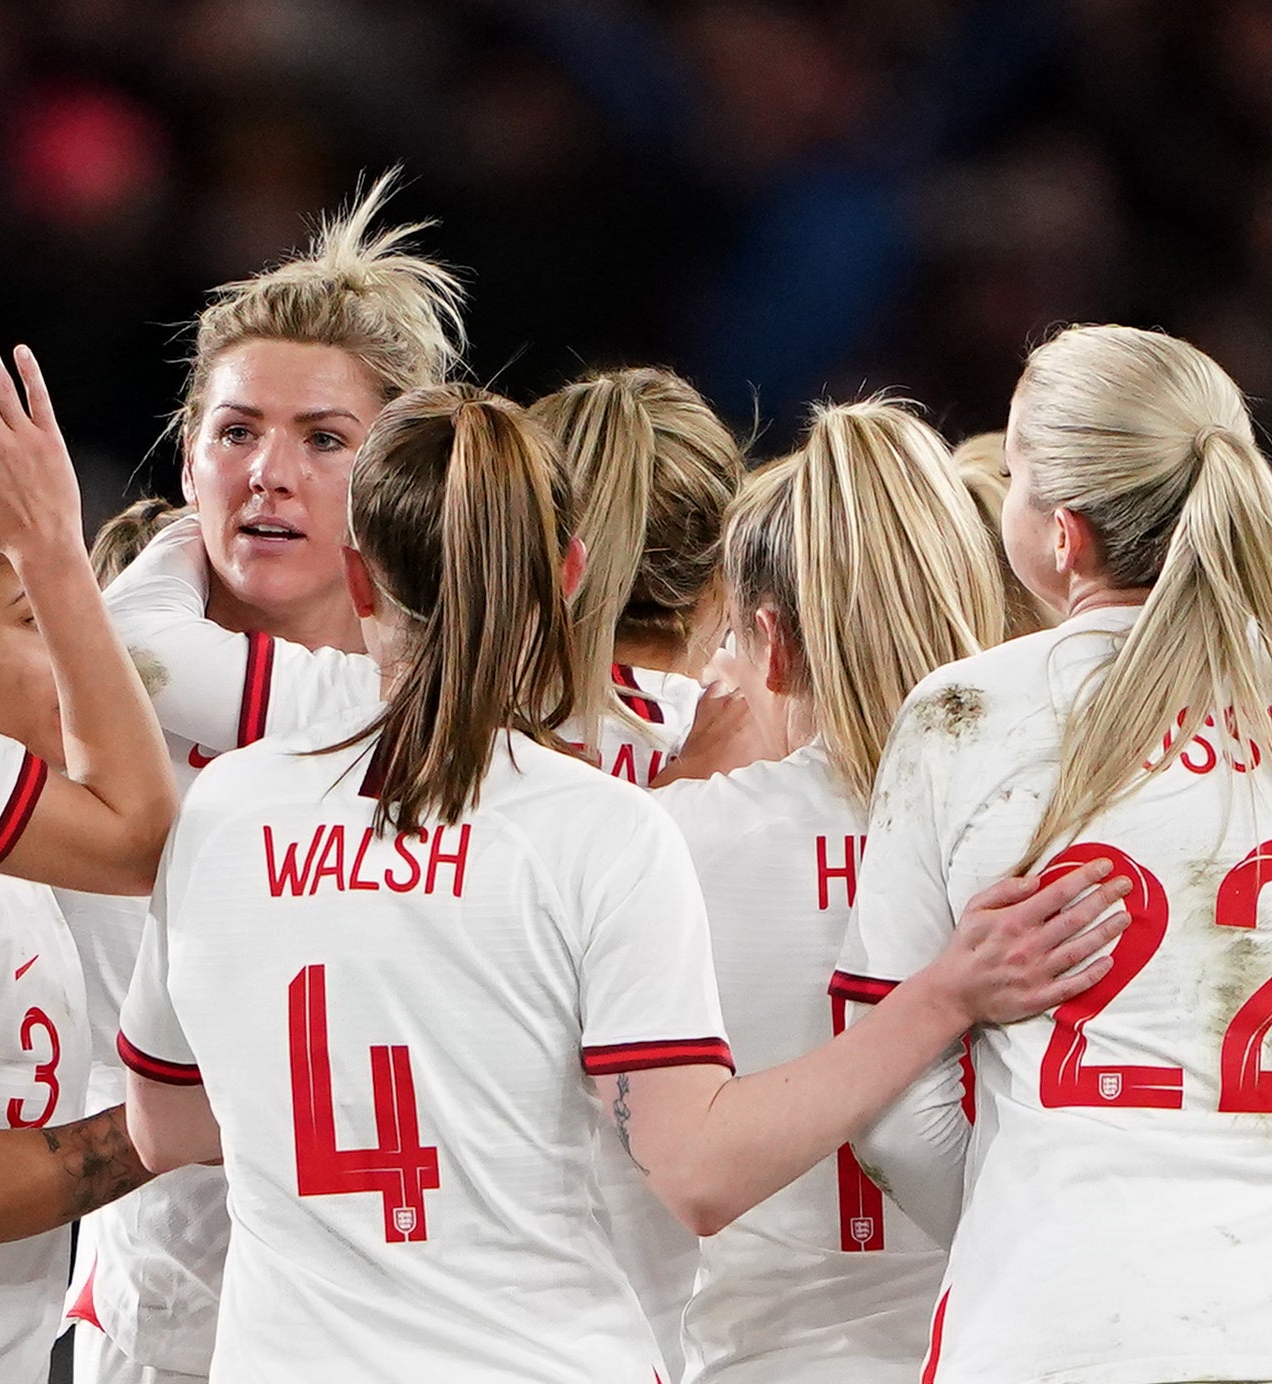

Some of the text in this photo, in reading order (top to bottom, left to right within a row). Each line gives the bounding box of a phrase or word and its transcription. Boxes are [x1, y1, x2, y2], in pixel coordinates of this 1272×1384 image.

[262, 823, 473, 899] WALSH
[815, 834, 868, 911] H
[6, 1006, 61, 1130] 3
[288, 964, 441, 1244] 4
